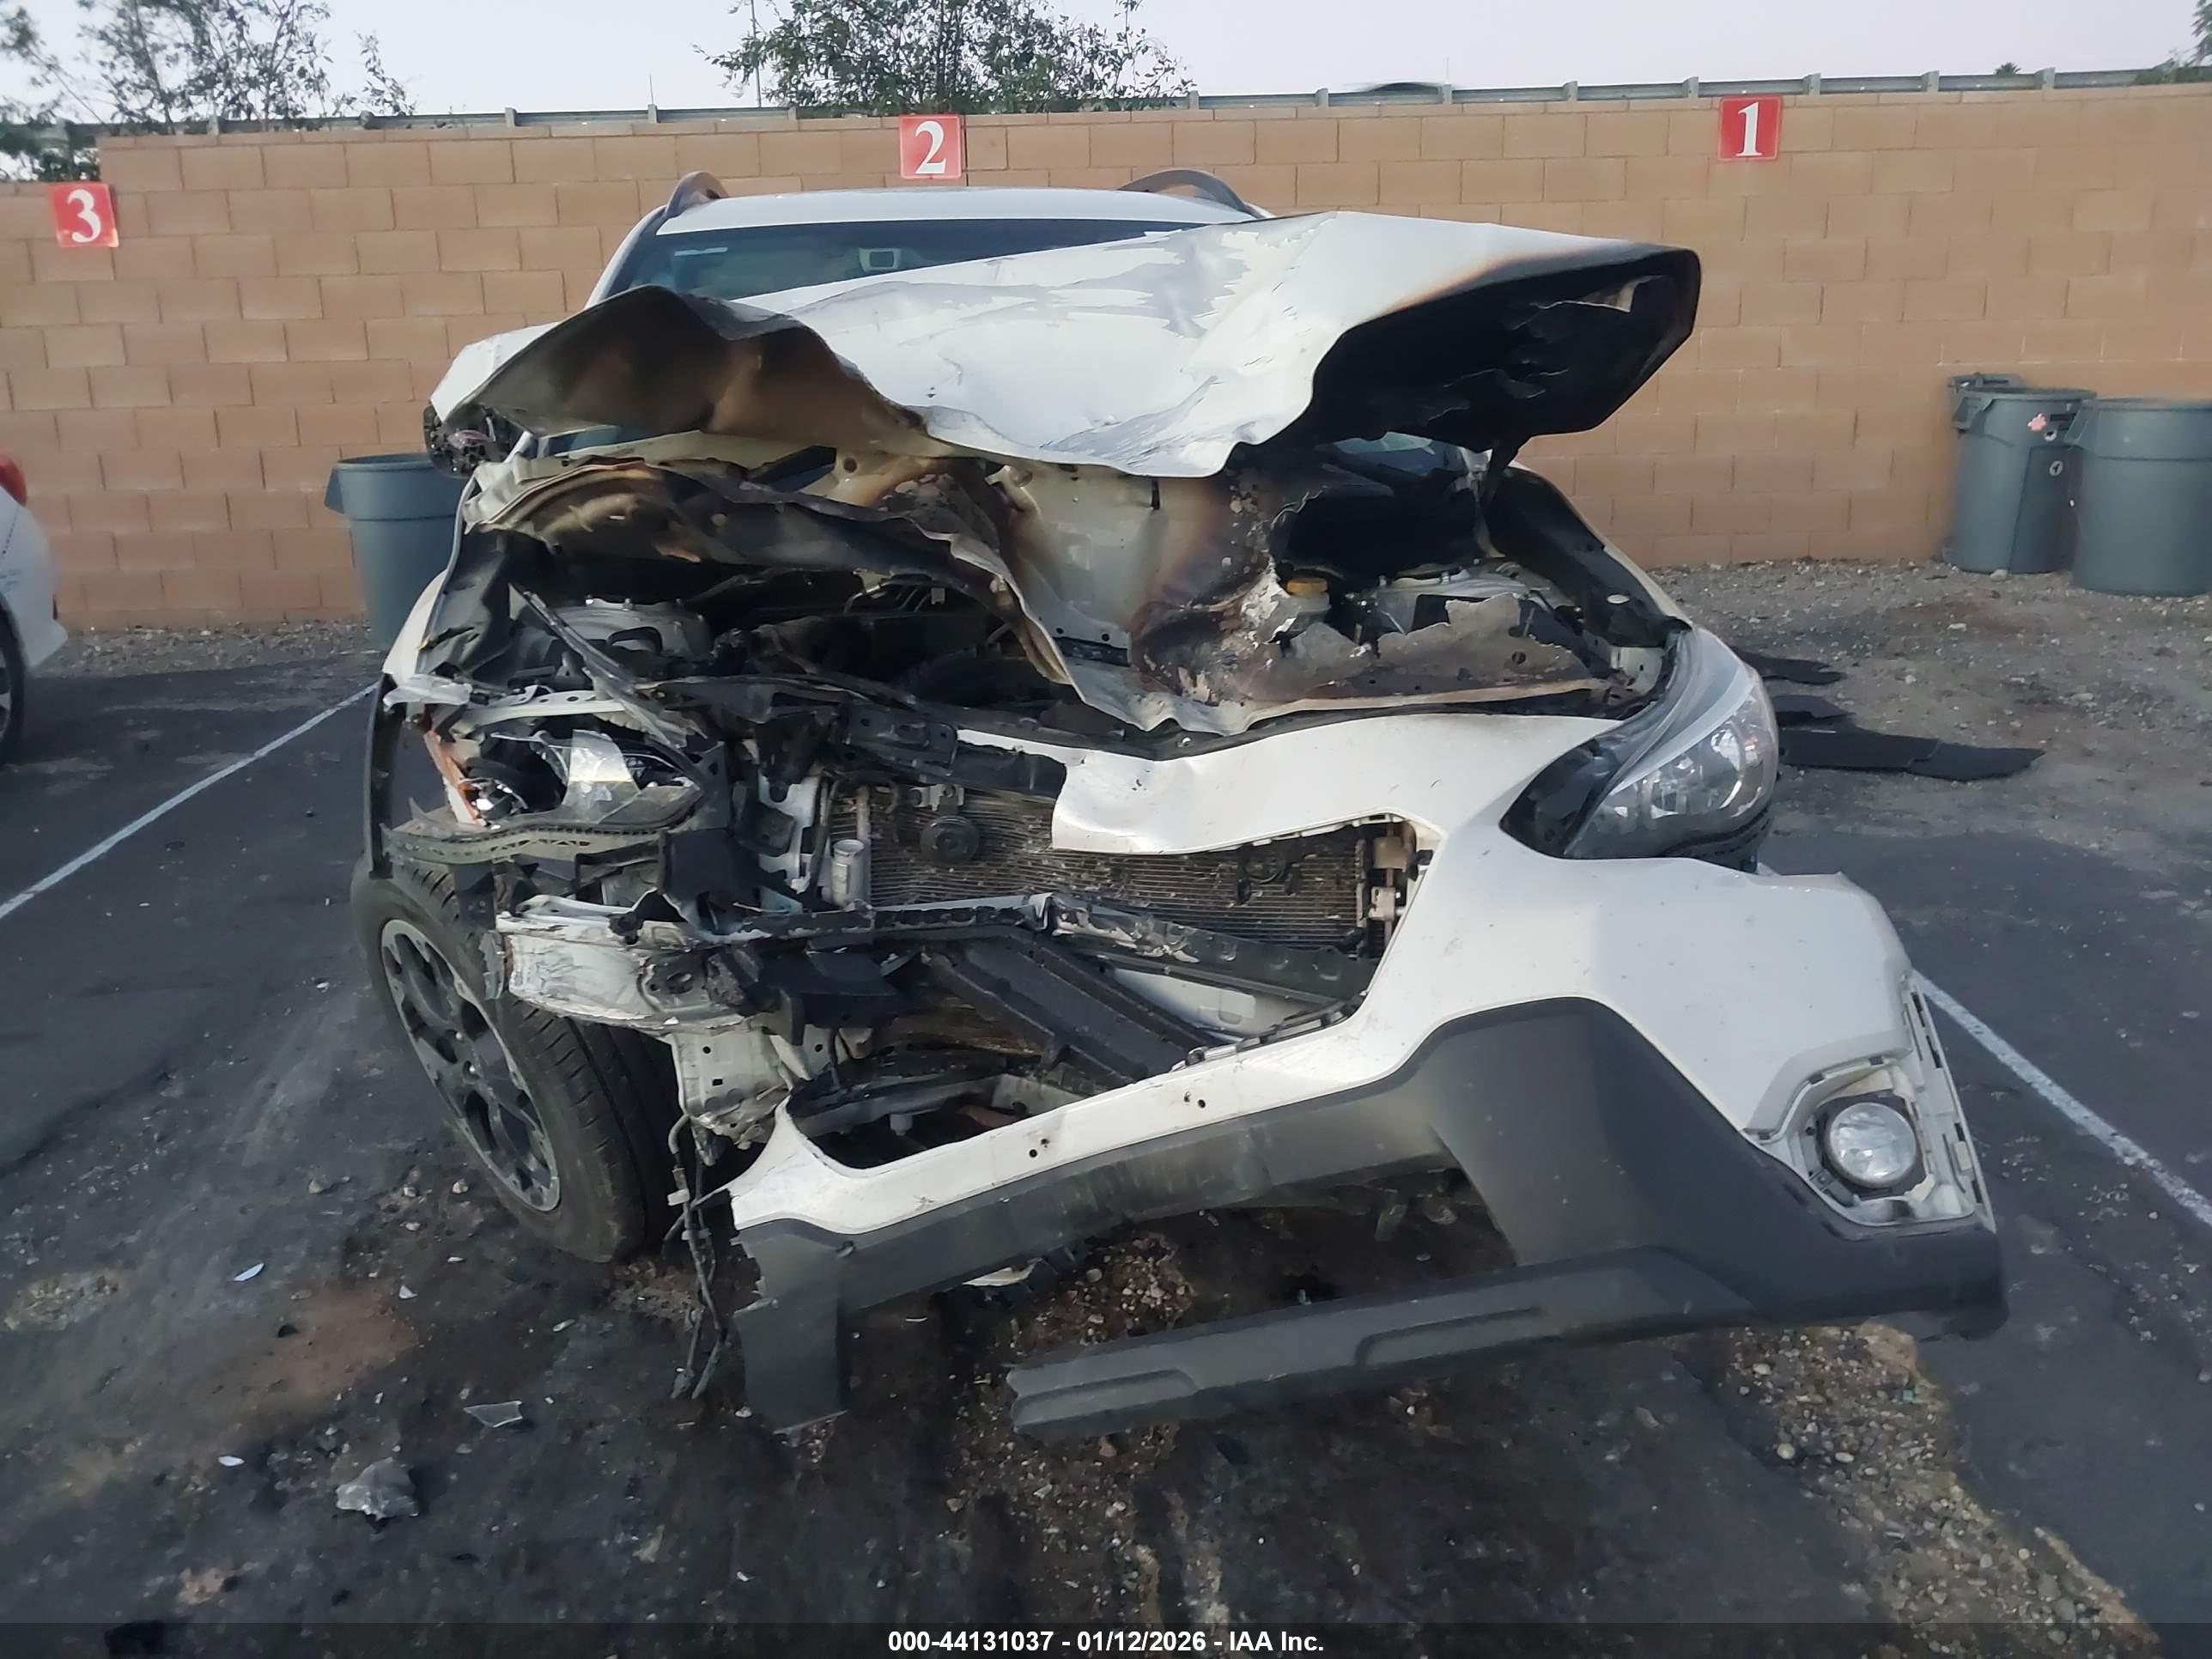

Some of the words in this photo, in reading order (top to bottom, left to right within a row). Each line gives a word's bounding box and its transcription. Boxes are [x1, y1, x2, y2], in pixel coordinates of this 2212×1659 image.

[915, 120, 947, 174] 2
[1735, 101, 1763, 157] 1
[67, 189, 102, 243] 3
